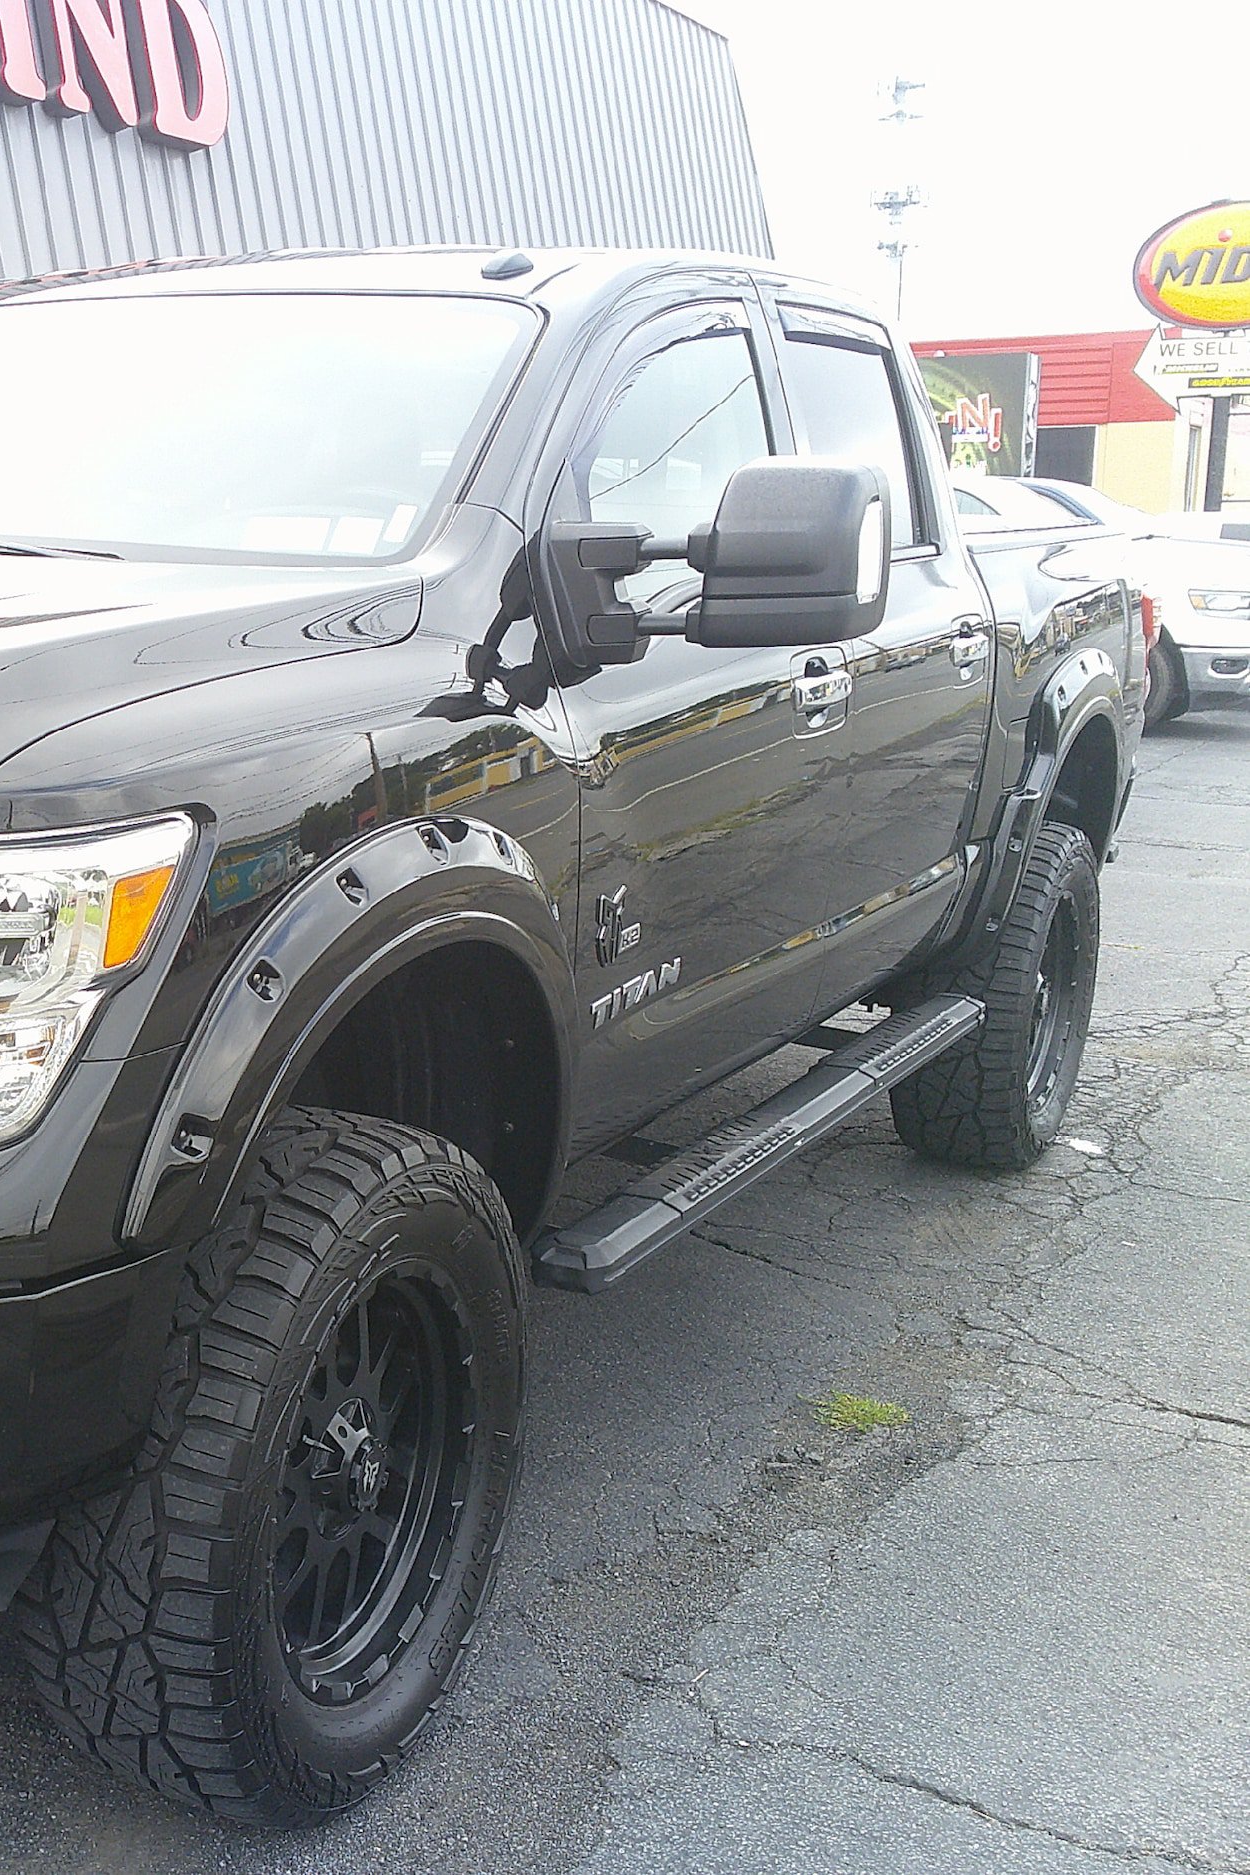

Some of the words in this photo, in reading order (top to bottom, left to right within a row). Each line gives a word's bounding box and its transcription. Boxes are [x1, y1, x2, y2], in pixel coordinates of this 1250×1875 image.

[1159, 343, 1186, 357] WE
[1193, 341, 1239, 356] SELL
[590, 956, 681, 1030] TITAN
